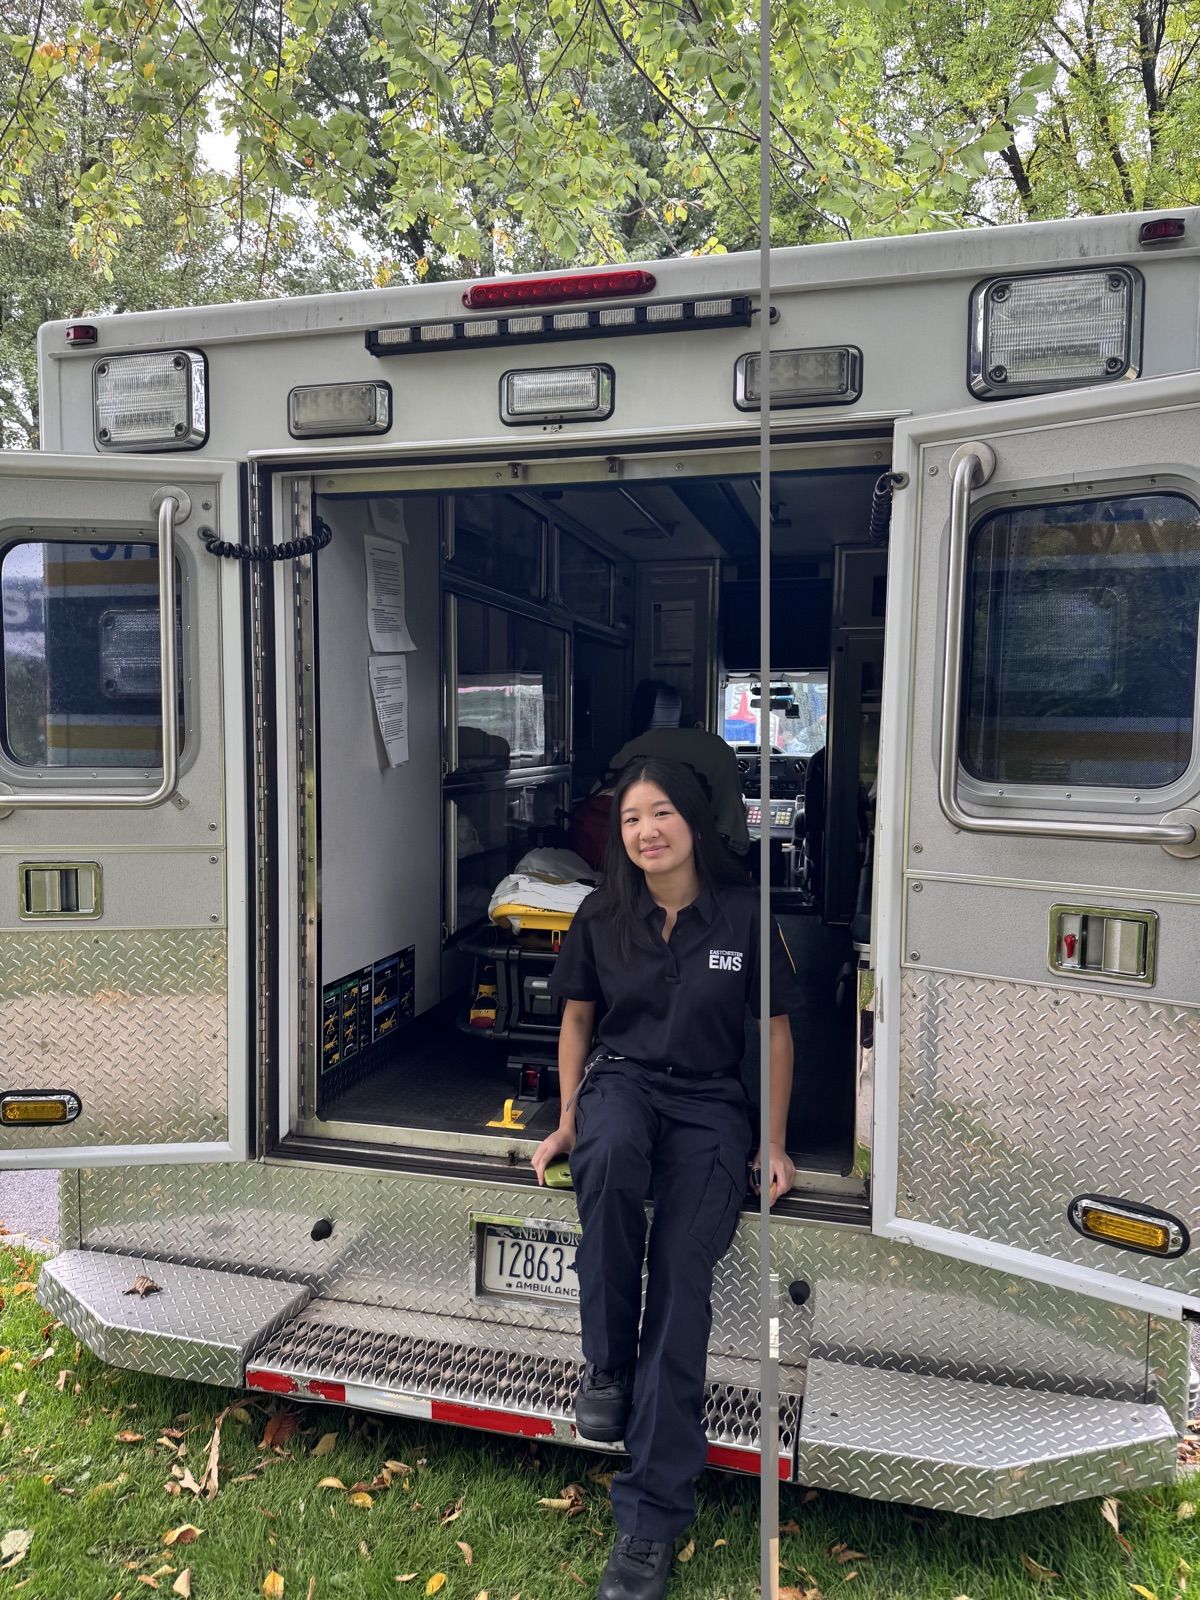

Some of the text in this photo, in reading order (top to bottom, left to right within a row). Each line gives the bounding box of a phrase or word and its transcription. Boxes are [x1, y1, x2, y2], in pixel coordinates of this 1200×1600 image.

[709, 954, 742, 972] EMS
[519, 1228, 581, 1246] NEW YOR
[497, 1240, 564, 1284] 12863
[516, 1281, 581, 1297] AMBULANC
